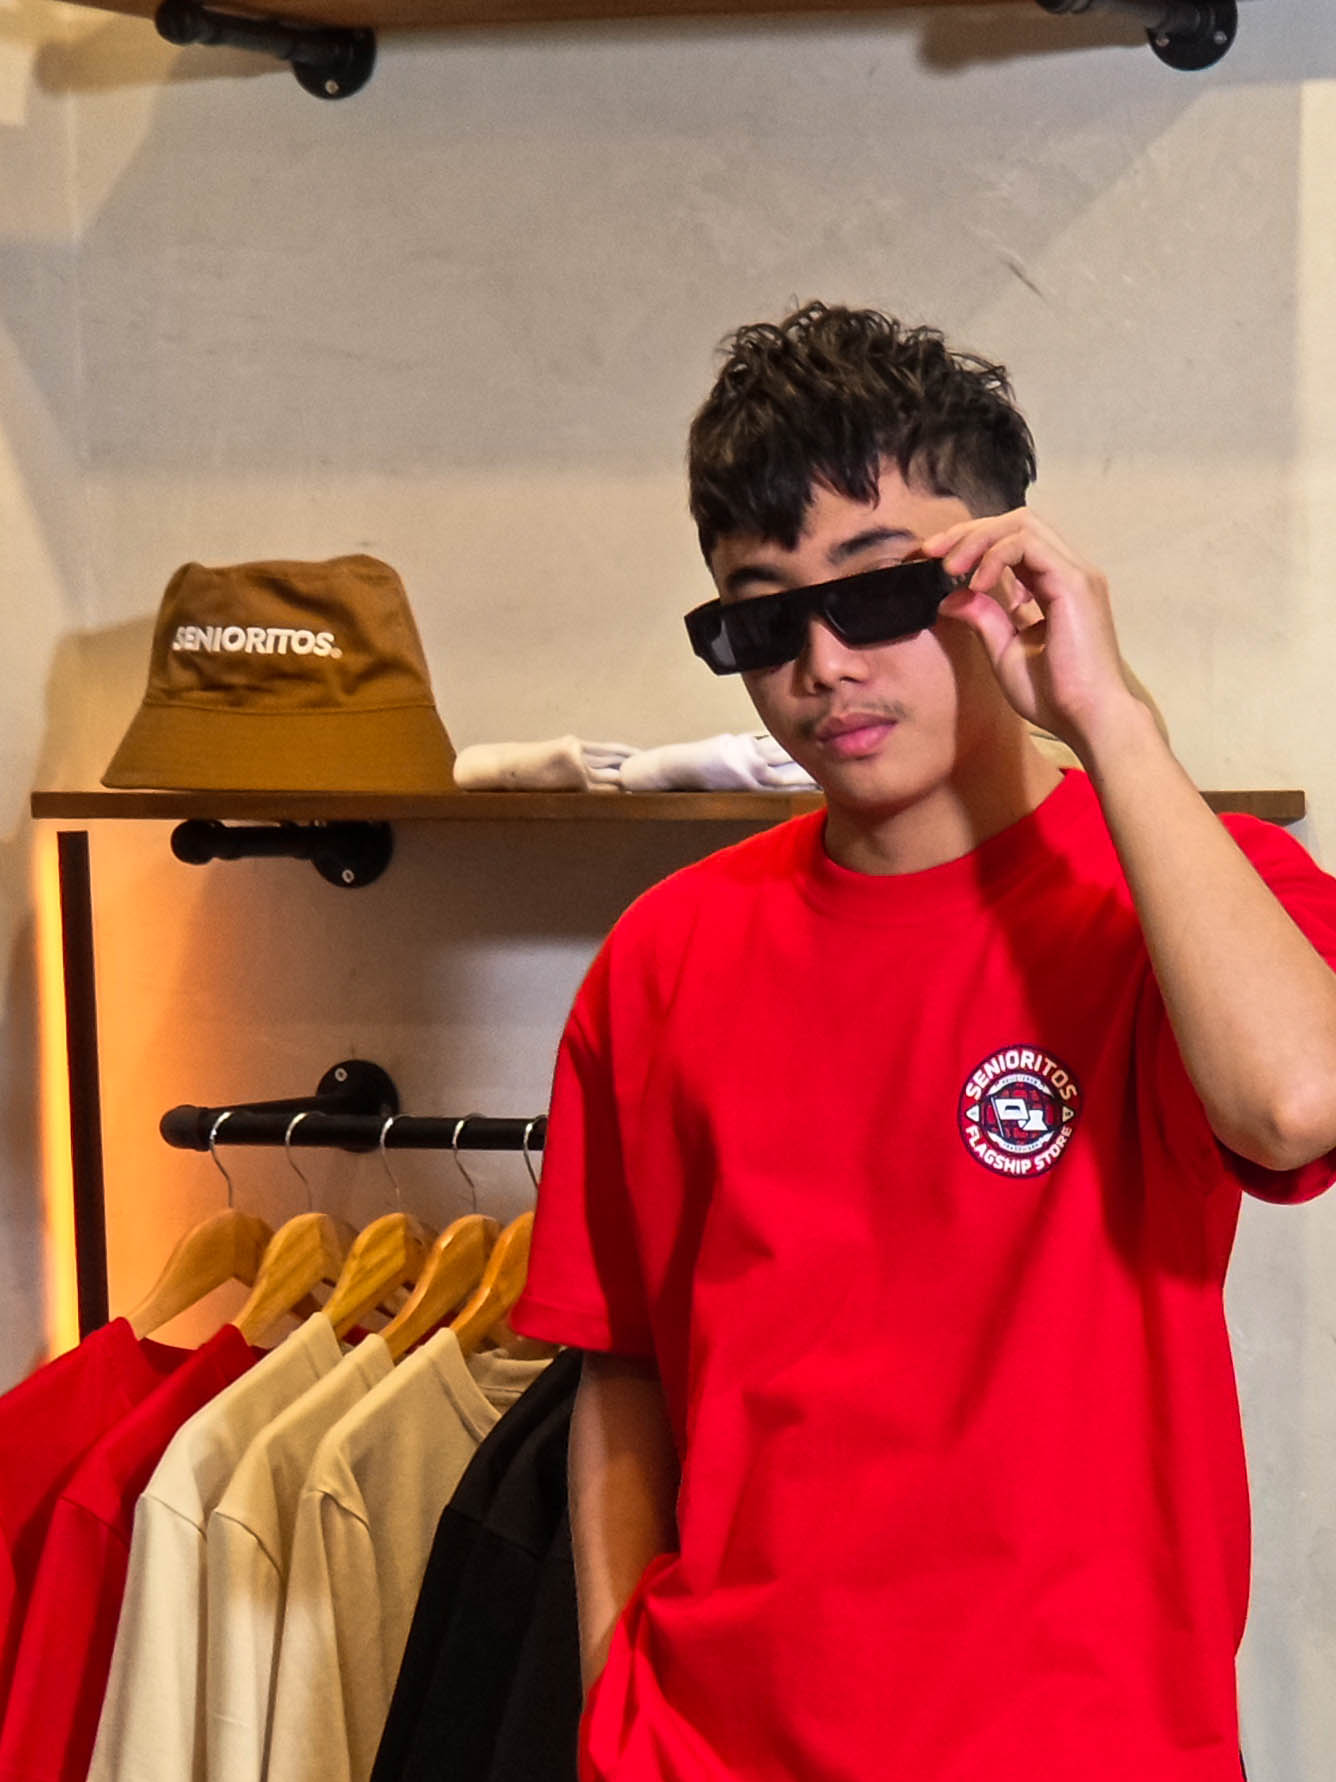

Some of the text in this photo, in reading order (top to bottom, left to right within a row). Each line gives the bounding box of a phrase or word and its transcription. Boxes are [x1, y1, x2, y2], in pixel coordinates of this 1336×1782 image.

[965, 1049, 1078, 1101] SENIORITOS
[965, 1124, 1073, 1174] FLAGSHIP STORE
